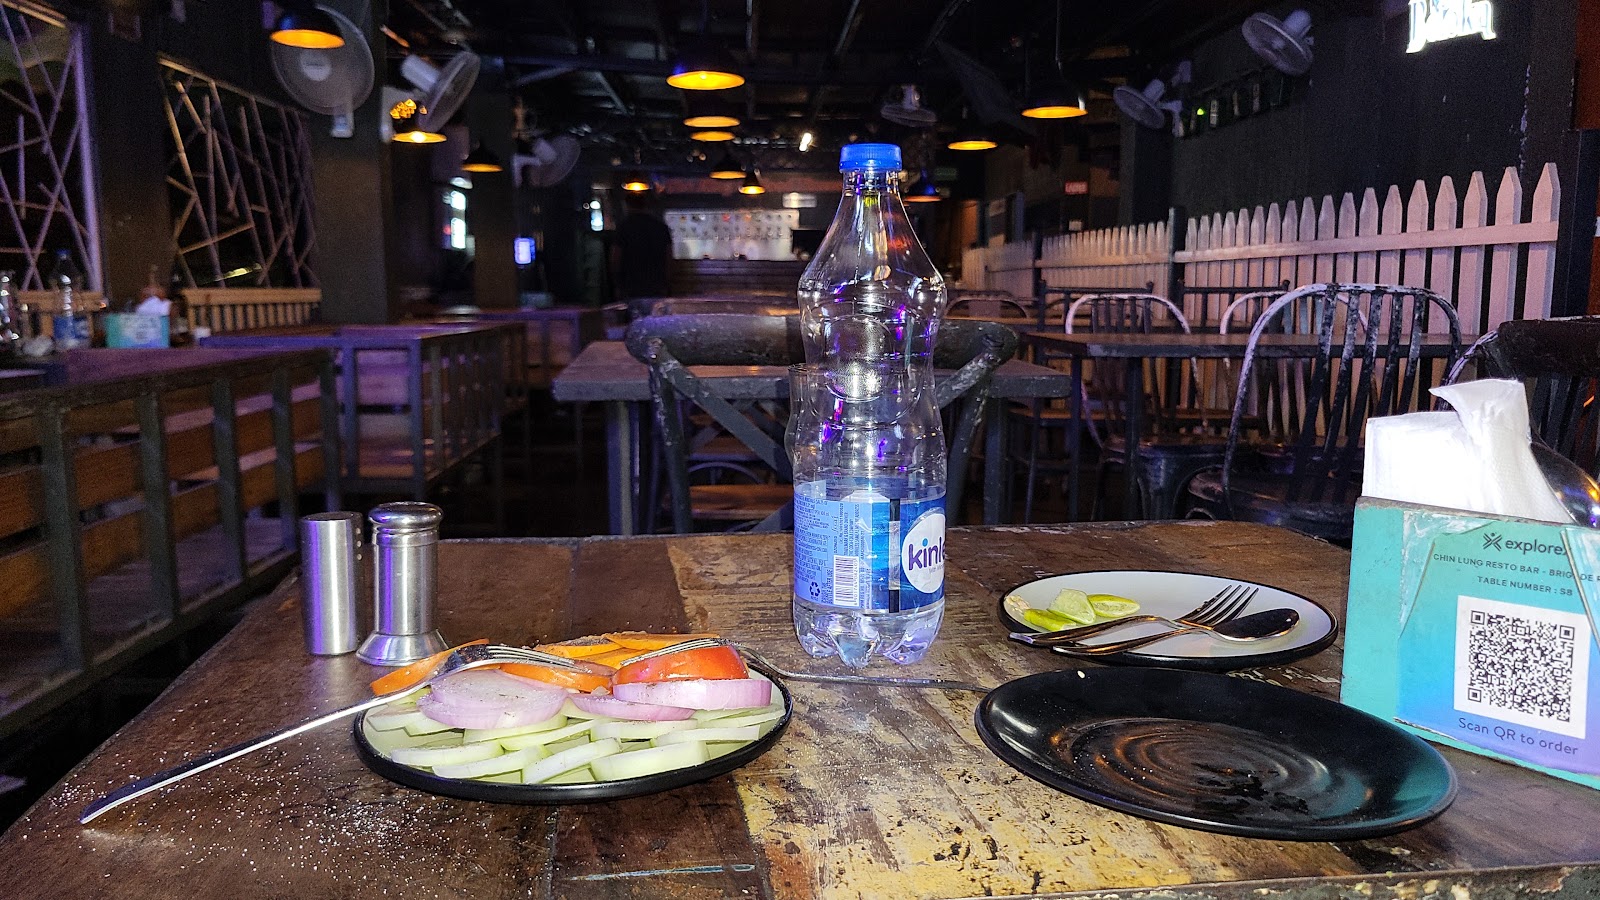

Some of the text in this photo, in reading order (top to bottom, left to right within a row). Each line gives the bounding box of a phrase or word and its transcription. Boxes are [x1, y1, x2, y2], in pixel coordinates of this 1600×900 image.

[1505, 539, 1567, 556] explore
[1433, 553, 1456, 563] CHIN
[1458, 557, 1483, 567] LUNG
[1486, 560, 1518, 571] RESTO
[1520, 564, 1540, 574] BAR
[1549, 568, 1593, 582] BRIGDE
[1477, 576, 1507, 587] TABLE
[1510, 580, 1551, 593] NUMBER
[1458, 717, 1578, 755] Scan QR to order
